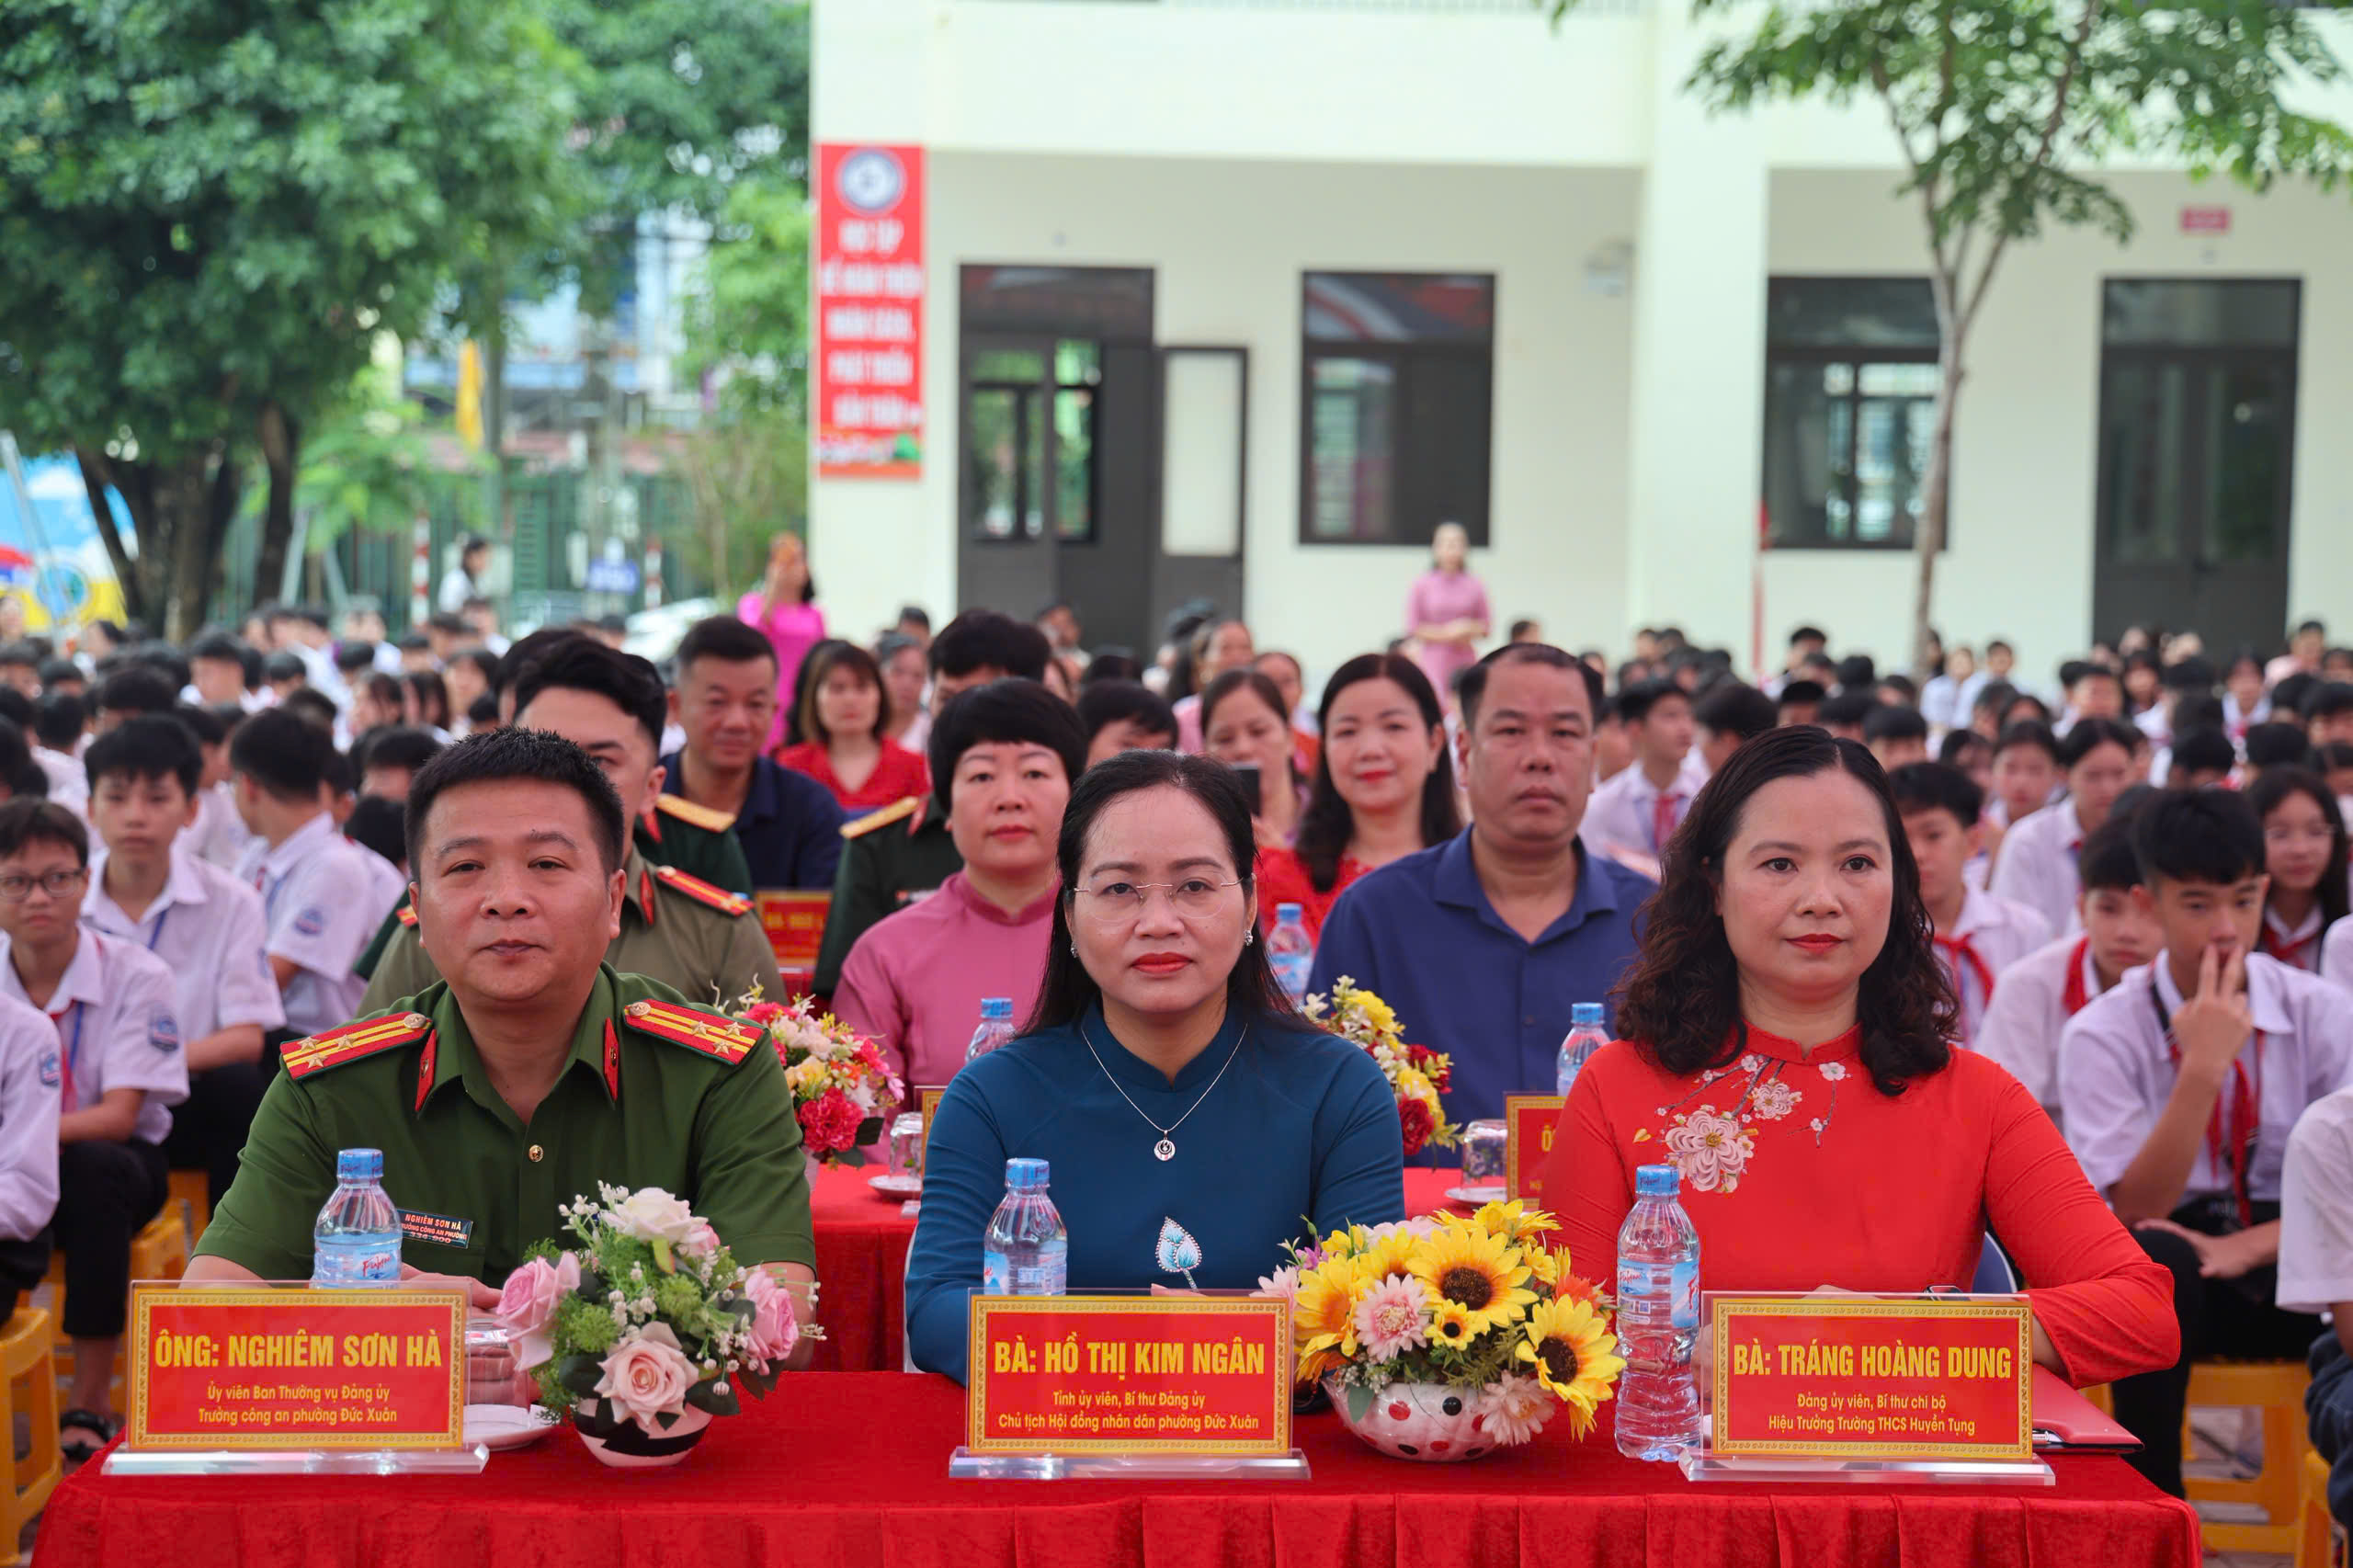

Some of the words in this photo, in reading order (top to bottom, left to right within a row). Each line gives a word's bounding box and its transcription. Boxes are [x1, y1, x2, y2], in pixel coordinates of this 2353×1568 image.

[404, 1214, 434, 1226] NGHIÊM
[435, 1219, 450, 1229] SƠN
[155, 1329, 219, 1368] ÔNG:
[228, 1329, 334, 1367] NGHIÊM
[343, 1333, 397, 1368] SƠN
[406, 1329, 442, 1367] HÀ
[994, 1335, 1037, 1373] BÀ:
[1044, 1331, 1079, 1374] HỒ
[1087, 1342, 1126, 1381] THỊ
[1134, 1343, 1184, 1374] KIM
[1192, 1336, 1265, 1374] NGÂN
[1733, 1338, 1771, 1376] BÀ:
[1778, 1338, 1854, 1377] TRÁNG
[1861, 1339, 1940, 1378] HOÀNG
[1948, 1346, 2012, 1379] DUNG
[208, 1381, 222, 1403] Ủy
[225, 1384, 251, 1400] viên
[253, 1385, 276, 1400] Ban
[278, 1384, 322, 1403] Thường
[324, 1388, 338, 1403] vụ
[341, 1382, 373, 1403] Đảng
[376, 1382, 391, 1403] ủy
[1052, 1390, 1075, 1405] Tỉnh
[1078, 1390, 1092, 1409] ủy
[1095, 1391, 1121, 1409] viên,
[1124, 1391, 1136, 1405] Bí
[1137, 1392, 1157, 1406] thư
[1158, 1390, 1189, 1410] Đảng
[1191, 1390, 1206, 1410] ủy
[1797, 1391, 1828, 1412] Đảng
[1831, 1392, 1845, 1412] ủy
[1847, 1392, 1874, 1412] viên,
[1876, 1392, 1889, 1408] Bí
[1890, 1394, 1910, 1409] thư
[1911, 1395, 1928, 1409] chi
[1931, 1394, 1947, 1414] bộ
[198, 1406, 238, 1426] Trưởng
[241, 1406, 272, 1426] công
[274, 1411, 290, 1423] an
[292, 1406, 337, 1426] phường
[340, 1406, 364, 1423] Đức
[367, 1406, 398, 1423] Xuân
[998, 1412, 1022, 1428] Chủ
[1024, 1414, 1046, 1432] tịch
[1049, 1414, 1067, 1432] Hội
[1070, 1410, 1099, 1432] đồng
[1102, 1414, 1131, 1428] nhân
[1132, 1414, 1155, 1429] dân
[1158, 1413, 1201, 1433] phường
[1204, 1414, 1227, 1429] Đức
[1229, 1414, 1259, 1429] Xuân
[1768, 1415, 1794, 1434] Hiệu
[1796, 1414, 1835, 1435] Trưởng
[1836, 1415, 1876, 1435] Trường
[1877, 1416, 1907, 1432] THCS
[1909, 1414, 1946, 1435] Huyền
[1948, 1417, 1976, 1436] Tụng
